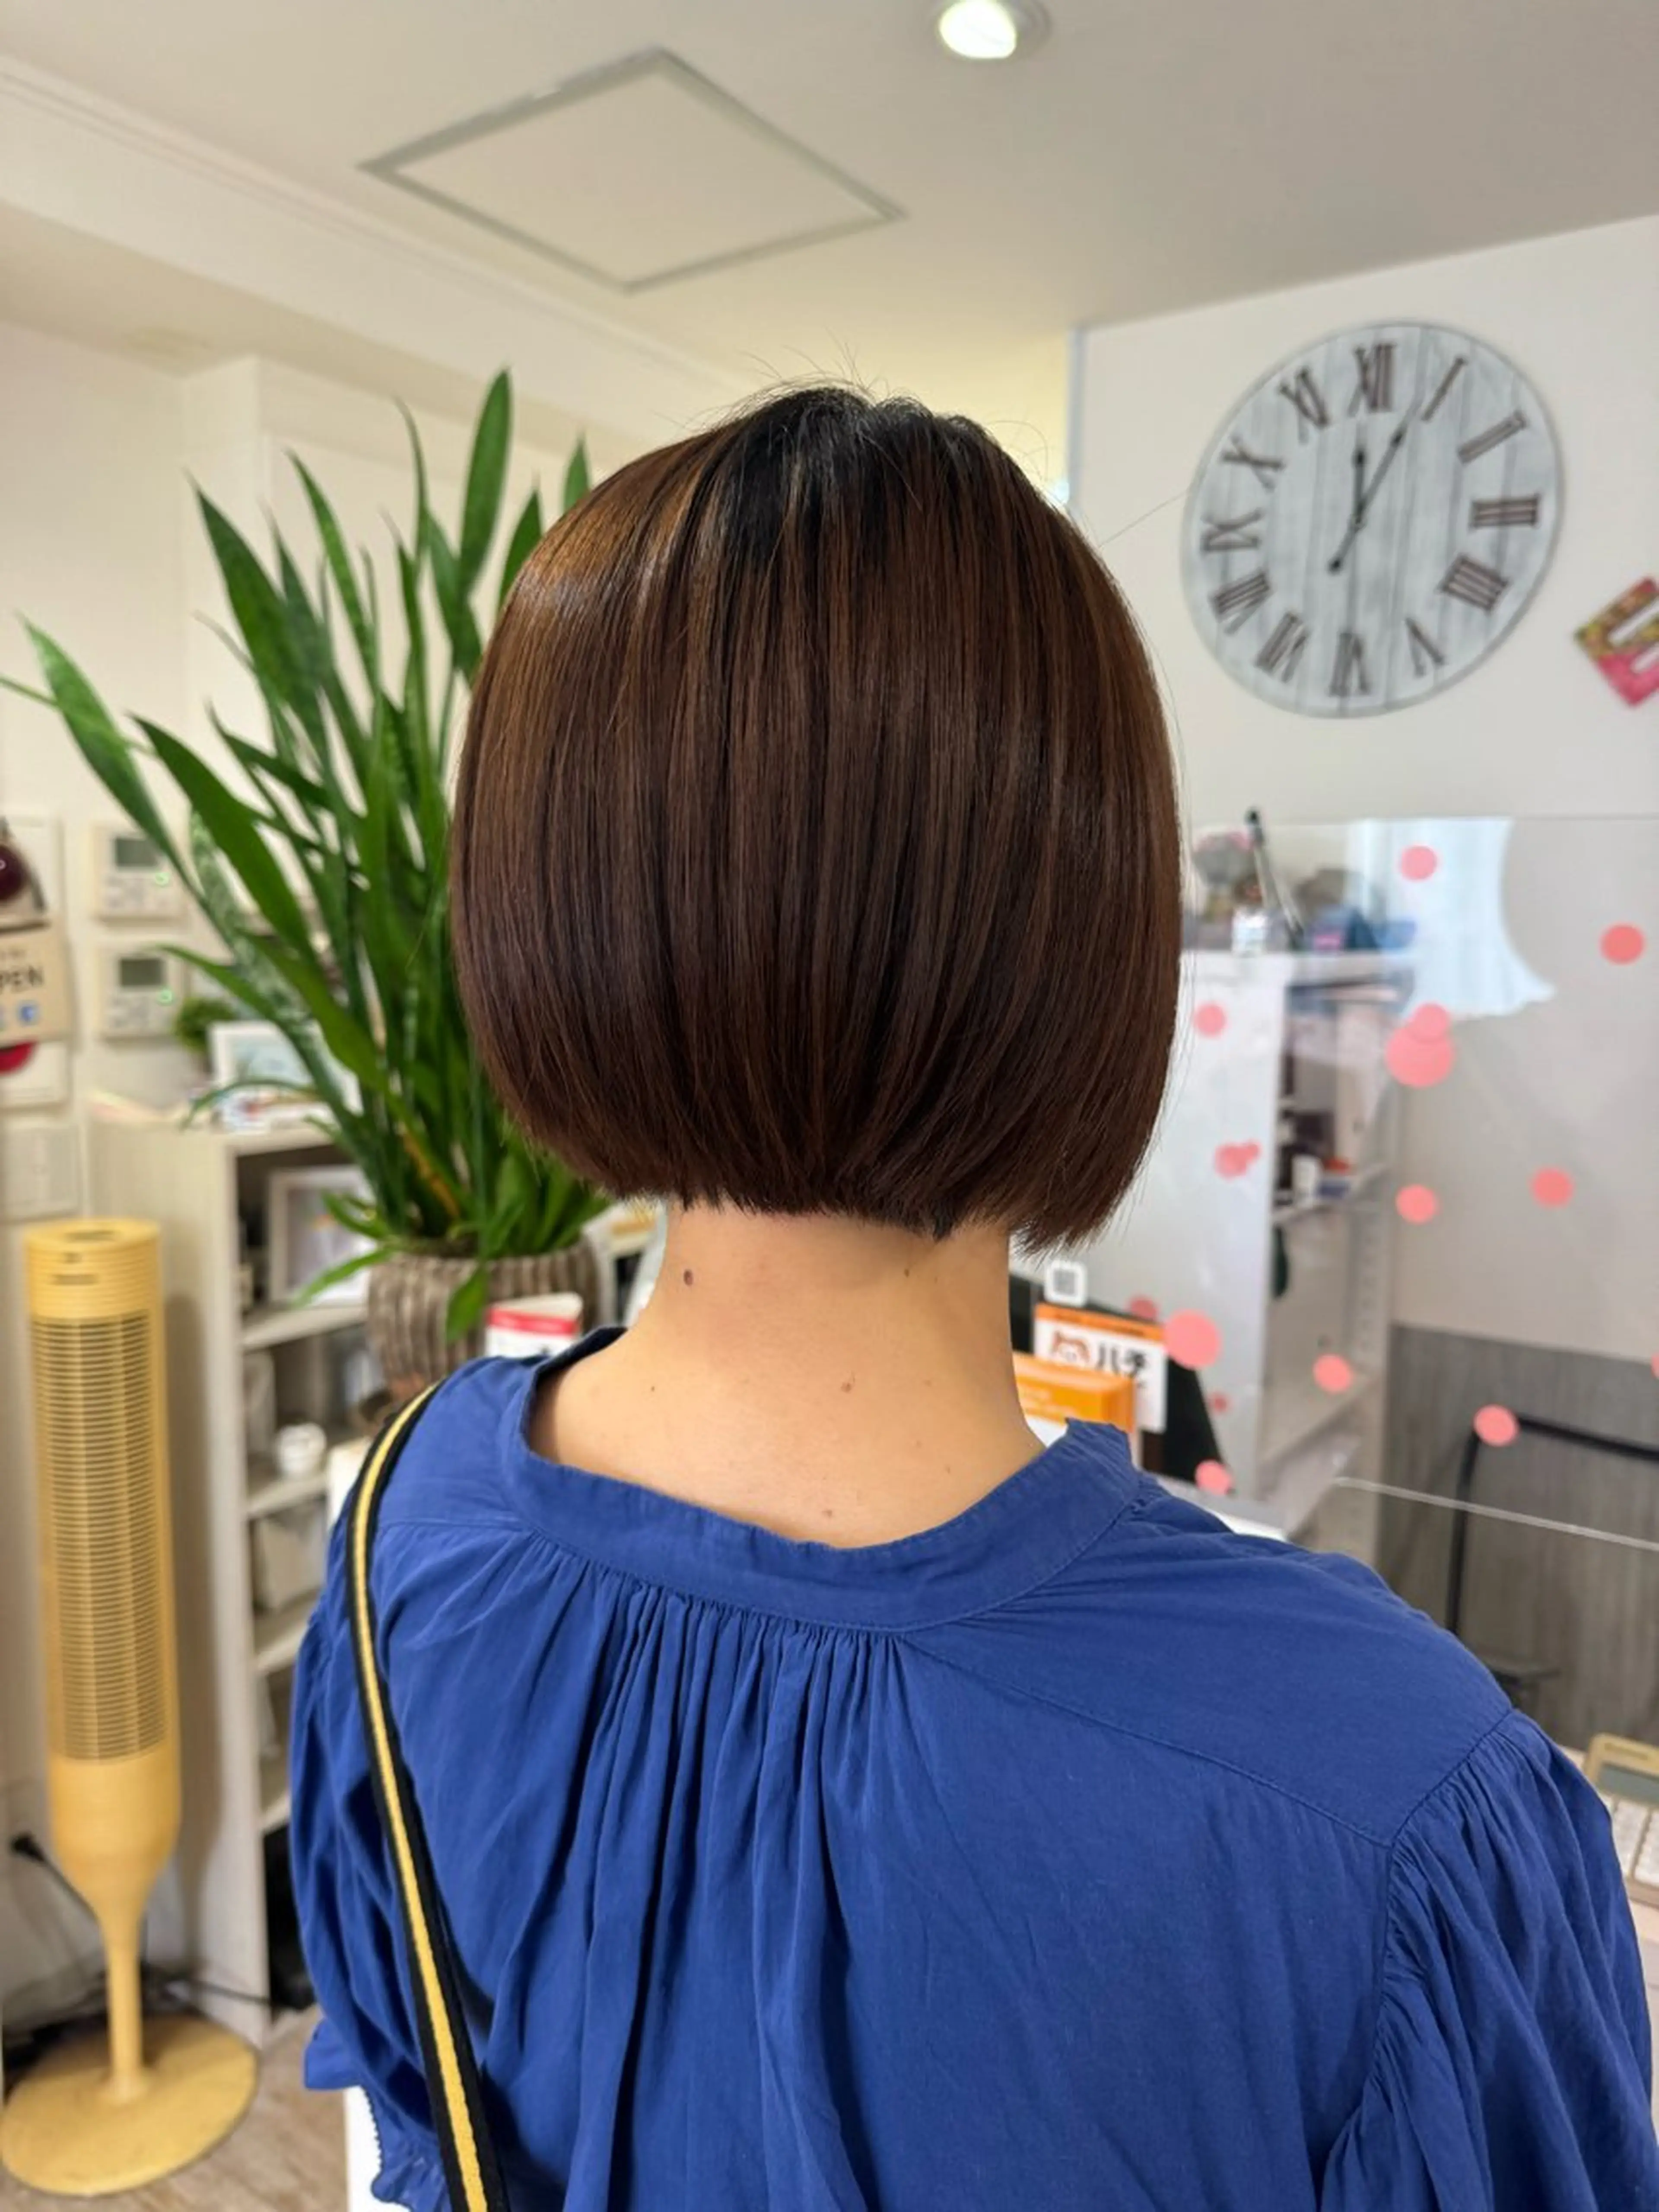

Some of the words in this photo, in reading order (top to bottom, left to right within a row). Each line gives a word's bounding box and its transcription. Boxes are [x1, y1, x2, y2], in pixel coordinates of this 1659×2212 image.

[1278, 368, 1329, 445] XI
[1347, 343, 1395, 418] XII
[1421, 357, 1468, 421] I
[1220, 434, 1284, 493] X
[1458, 410, 1526, 464] II
[1201, 509, 1264, 553] IX
[1470, 494, 1540, 530] III
[1212, 572, 1271, 634] VIII
[1254, 611, 1308, 682] VII
[1328, 633, 1373, 697] VI
[1405, 618, 1445, 677] V
